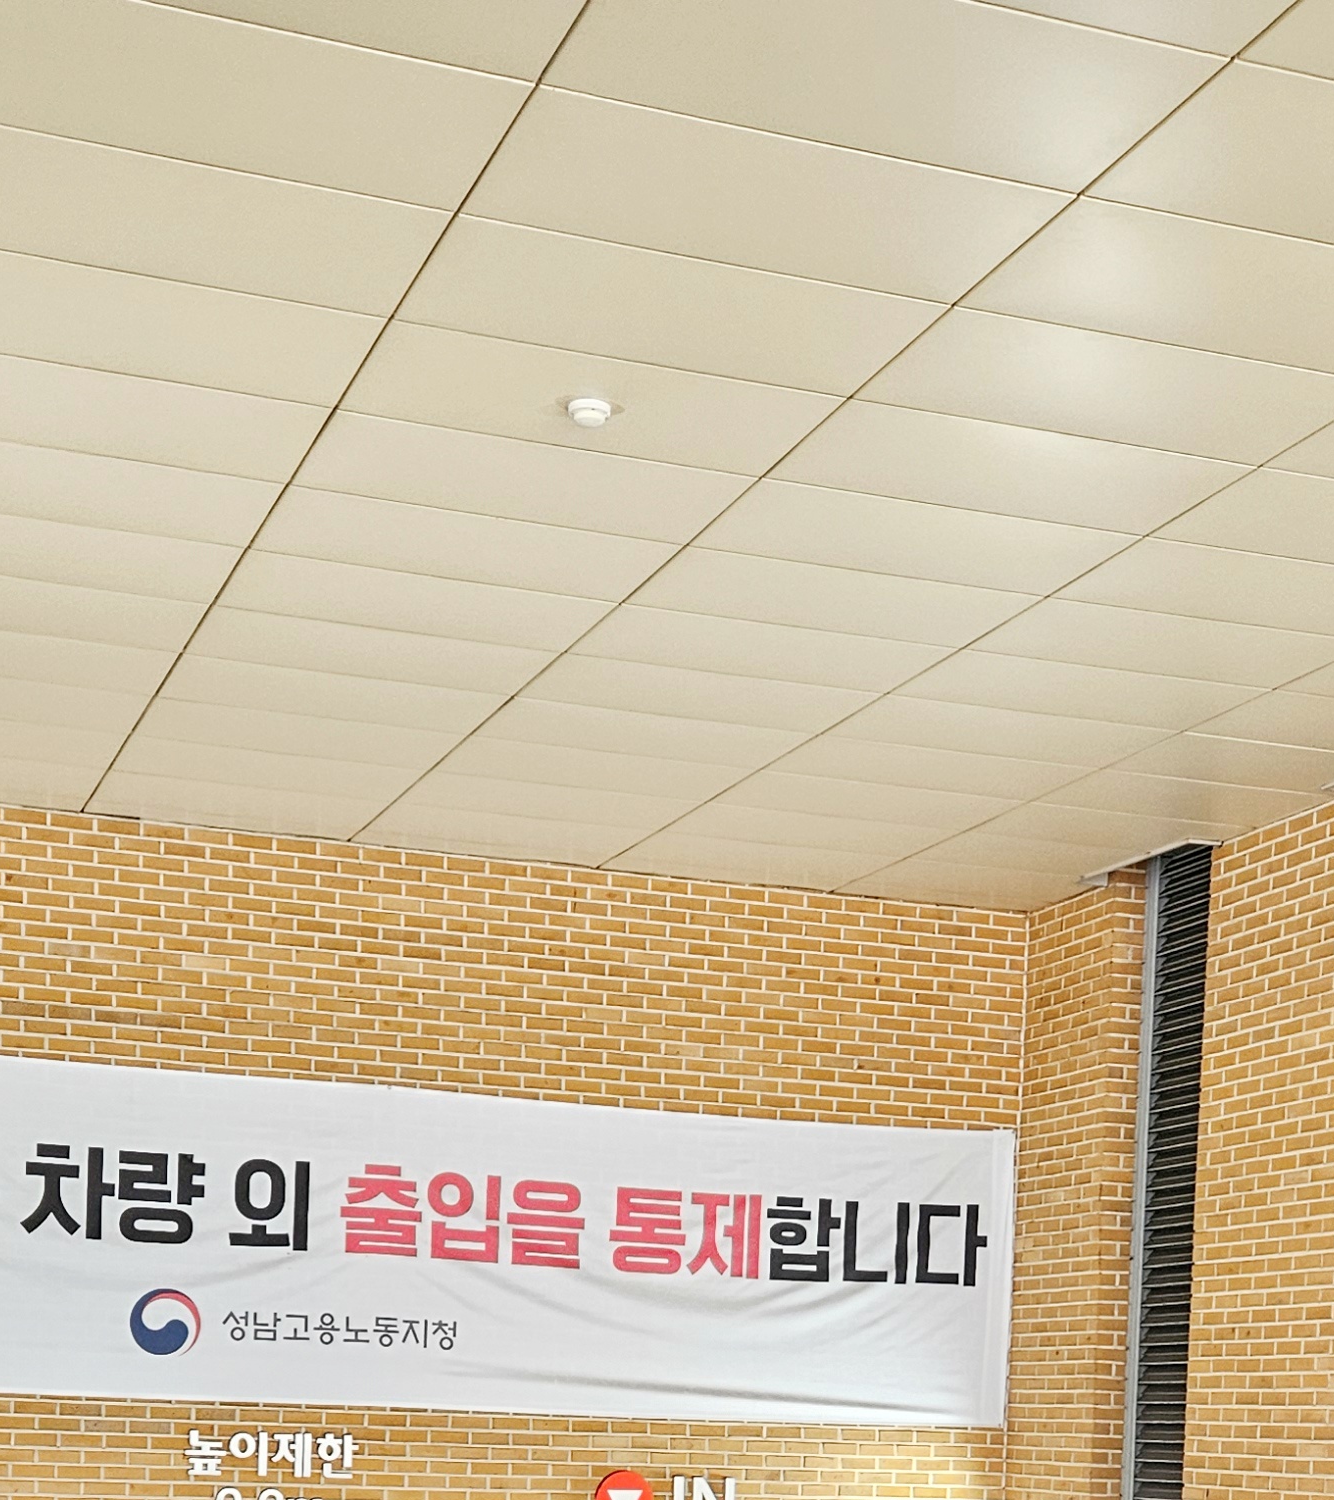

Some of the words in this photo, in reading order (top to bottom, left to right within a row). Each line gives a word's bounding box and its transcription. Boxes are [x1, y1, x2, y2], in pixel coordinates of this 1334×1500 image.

[20, 1143, 206, 1245] 차량
[228, 1158, 311, 1252] 외
[340, 1164, 584, 1269] 출입을
[609, 1187, 988, 1287] 통제합니다
[222, 1310, 458, 1351] 성남고용노동지청
[184, 1430, 360, 1480] 높이제한
